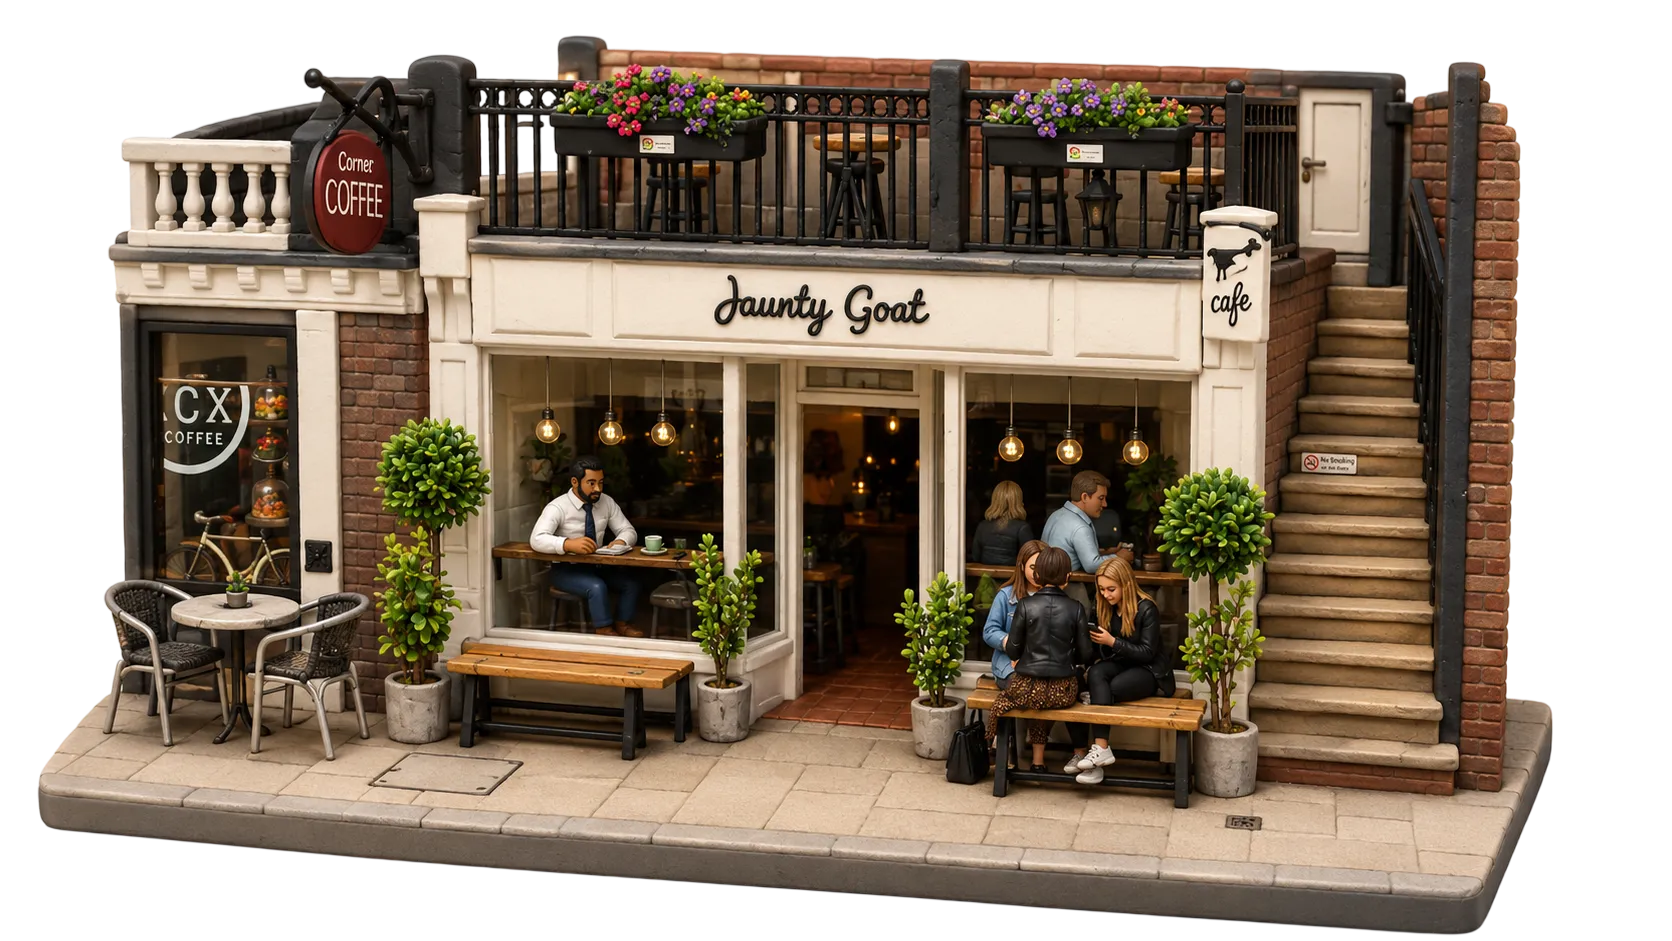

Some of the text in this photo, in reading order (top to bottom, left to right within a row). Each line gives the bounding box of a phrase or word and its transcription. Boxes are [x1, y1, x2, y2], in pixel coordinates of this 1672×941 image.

[338, 151, 374, 173] Corner
[325, 178, 384, 218] COFFEE
[714, 274, 930, 336] Jaunty Goat
[1211, 281, 1252, 327] cafe
[163, 385, 232, 424] CX
[164, 430, 223, 445] COFFEE
